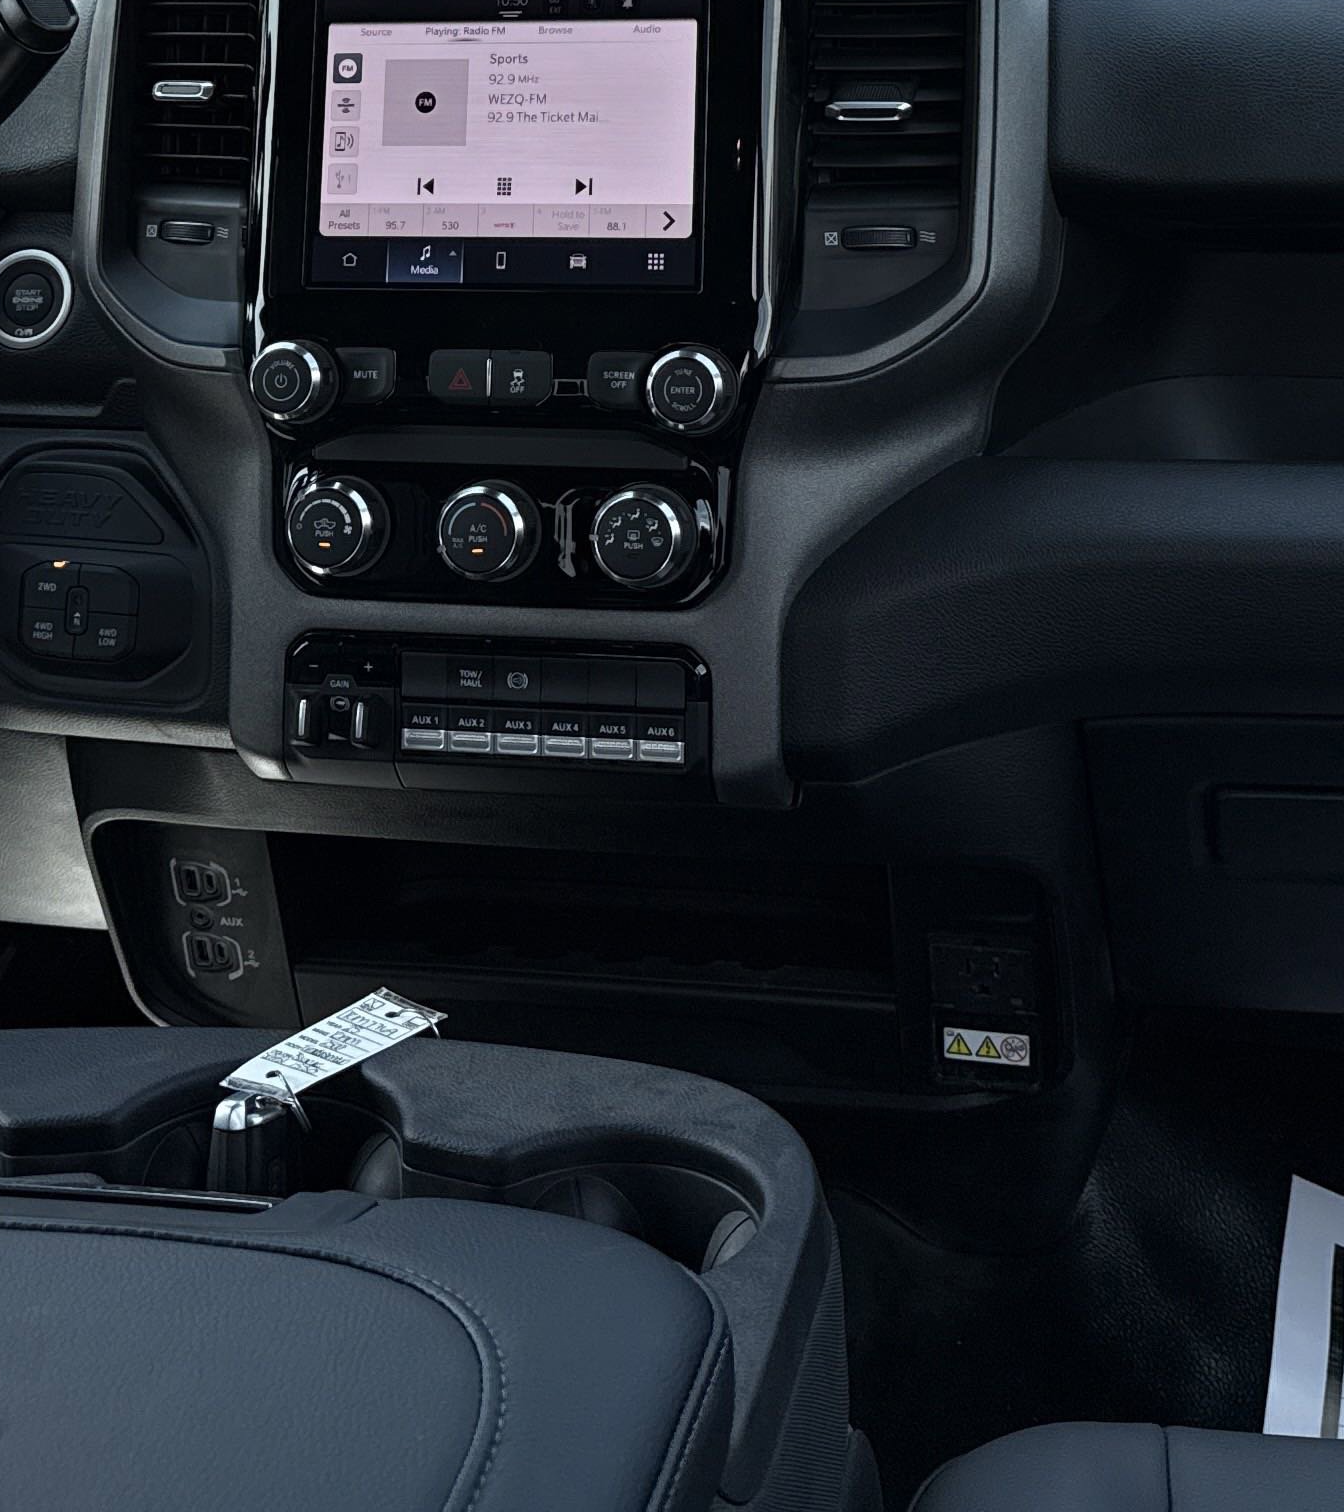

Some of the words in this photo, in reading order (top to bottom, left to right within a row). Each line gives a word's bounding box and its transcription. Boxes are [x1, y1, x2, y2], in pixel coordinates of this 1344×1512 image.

[360, 27, 393, 38] Source
[463, 26, 489, 36] Radio
[491, 26, 507, 35] FM
[538, 25, 574, 36] Browse
[633, 23, 662, 34] Audio
[489, 53, 530, 67] Sports
[341, 65, 355, 73] FM
[488, 73, 516, 86] 92.9
[517, 74, 540, 85] MHz
[419, 97, 434, 108] FM
[488, 94, 549, 107] WEZQ-FM
[487, 111, 516, 124] 92.9
[517, 111, 538, 123] The
[540, 110, 575, 123] Ticket
[339, 209, 351, 219] All
[327, 220, 361, 232] Presets
[385, 221, 406, 231] 95.7
[441, 221, 459, 231] 530
[606, 221, 627, 231] 88.1
[410, 264, 439, 276] Media
[353, 370, 379, 380] MUTE
[602, 370, 635, 380] SCREEN
[610, 380, 628, 389] OFF
[510, 385, 525, 395] OFF
[670, 386, 696, 395] ENTER
[671, 401, 697, 412] SCROLL
[314, 529, 335, 537] PUSH
[469, 524, 488, 534] A/C
[468, 535, 488, 544] PUSH
[623, 540, 644, 551] PUSH
[37, 582, 57, 592] 2WD
[34, 622, 54, 631] 4WD
[32, 631, 53, 640] HIGH
[98, 628, 118, 637] 4WD
[98, 637, 117, 646] LOW
[459, 669, 483, 679] TOW/
[330, 679, 350, 688] GAIN
[460, 678, 483, 688] HAUL
[412, 715, 431, 725] AUX
[458, 718, 476, 727] AUX
[505, 720, 523, 730] AUX
[551, 722, 570, 732] AUX
[599, 725, 617, 734] AUX
[647, 727, 666, 737] AUX
[220, 916, 244, 927] AUX
